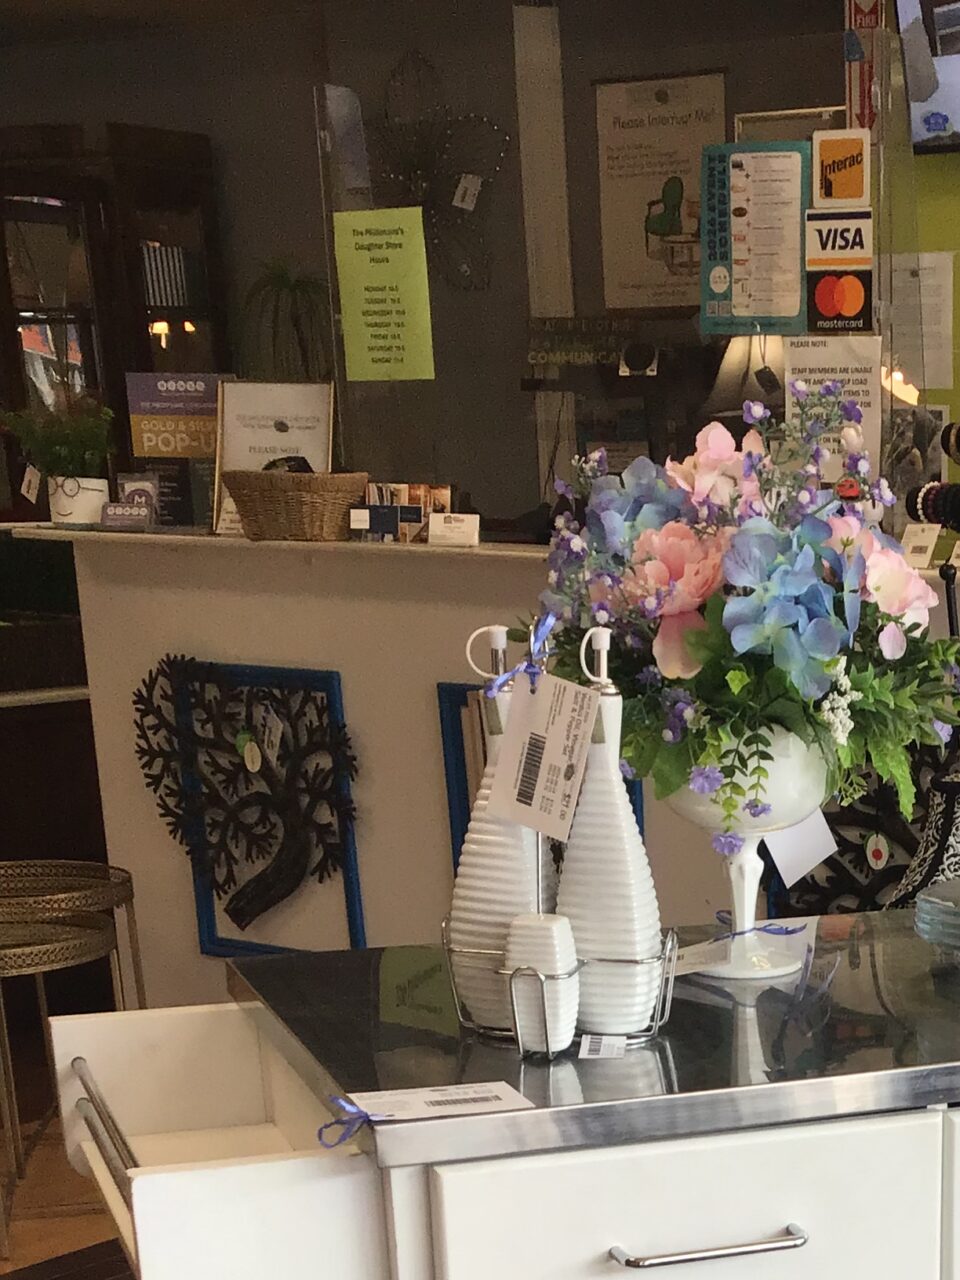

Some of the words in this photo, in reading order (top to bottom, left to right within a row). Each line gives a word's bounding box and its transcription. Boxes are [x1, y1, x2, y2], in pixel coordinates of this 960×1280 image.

[856, 15, 877, 27] FIRE
[820, 151, 864, 178] Interac
[718, 154, 729, 262] SCHEDULE
[814, 227, 865, 251] VISA
[816, 318, 864, 329] mastercard
[790, 340, 809, 348] PLEASE
[791, 367, 807, 375] STAFF
[808, 367, 838, 375] MEMBERS
[851, 366, 872, 374] UNABLE
[852, 378, 868, 386] LOAD
[141, 420, 175, 431] GOLD
[178, 420, 187, 430] &
[142, 432, 216, 452] POP-U
